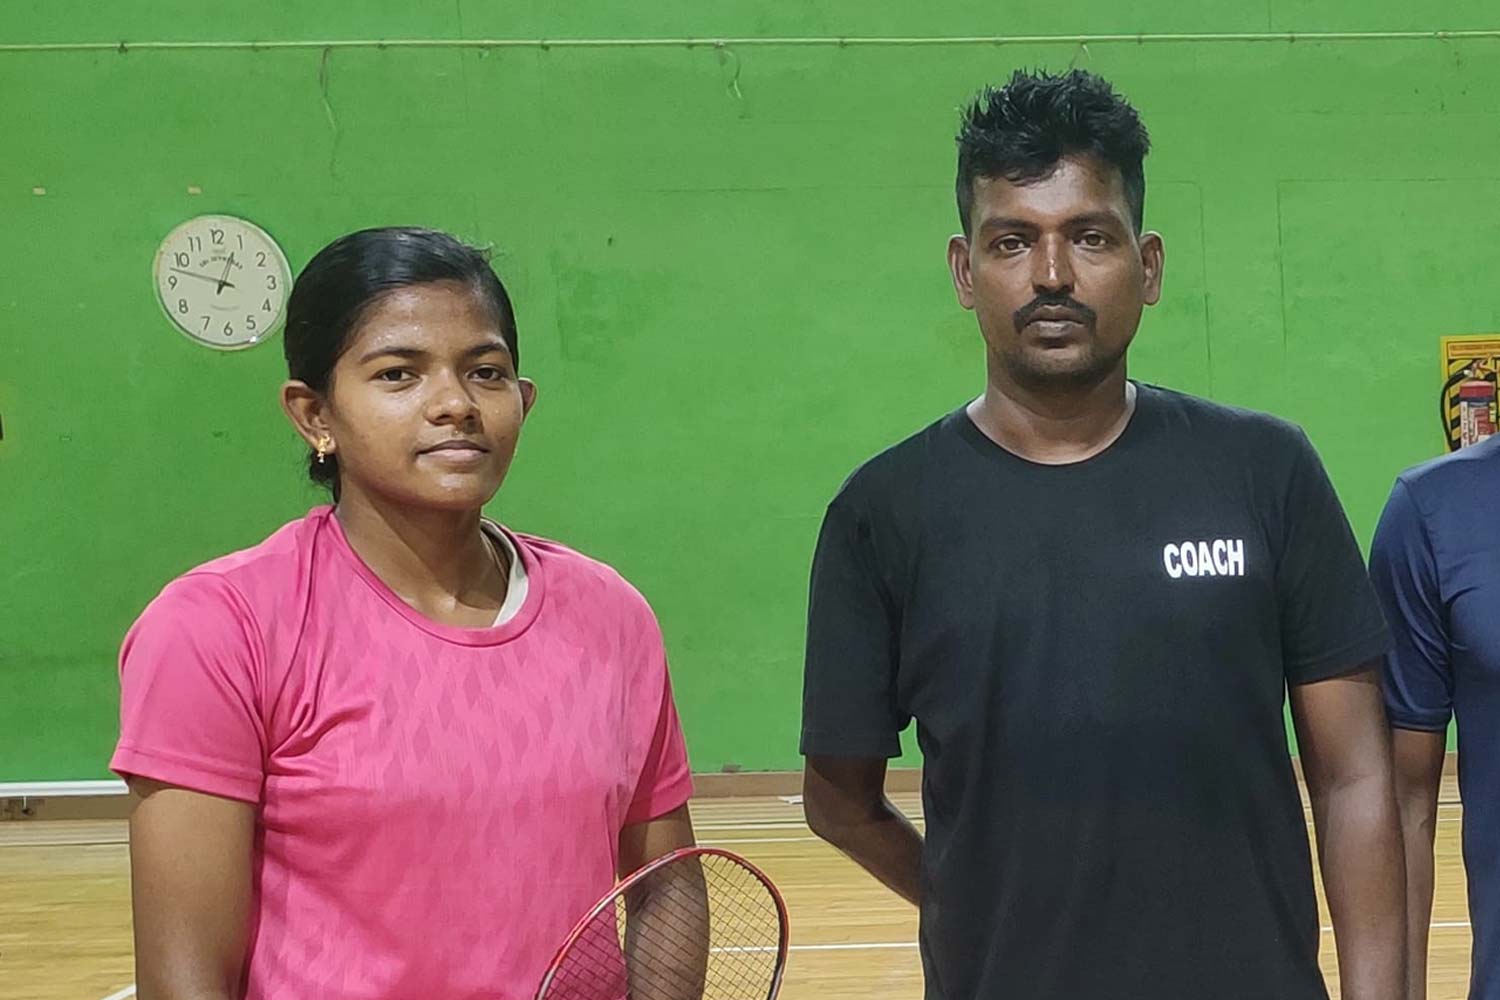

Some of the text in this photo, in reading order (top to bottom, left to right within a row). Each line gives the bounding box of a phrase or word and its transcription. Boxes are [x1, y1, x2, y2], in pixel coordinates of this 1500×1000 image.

[188, 236, 201, 252] 11
[210, 228, 224, 245] 12
[237, 234, 243, 250] 1
[174, 252, 190, 268] 10
[256, 252, 266, 267] 2
[168, 275, 177, 290] 9
[266, 275, 277, 290] 3
[178, 299, 188, 314] 8
[262, 299, 271, 312] 4
[201, 316, 210, 331] 7
[223, 321, 233, 337] 6
[246, 315, 256, 330] 5
[1163, 539, 1244, 579] COACH
